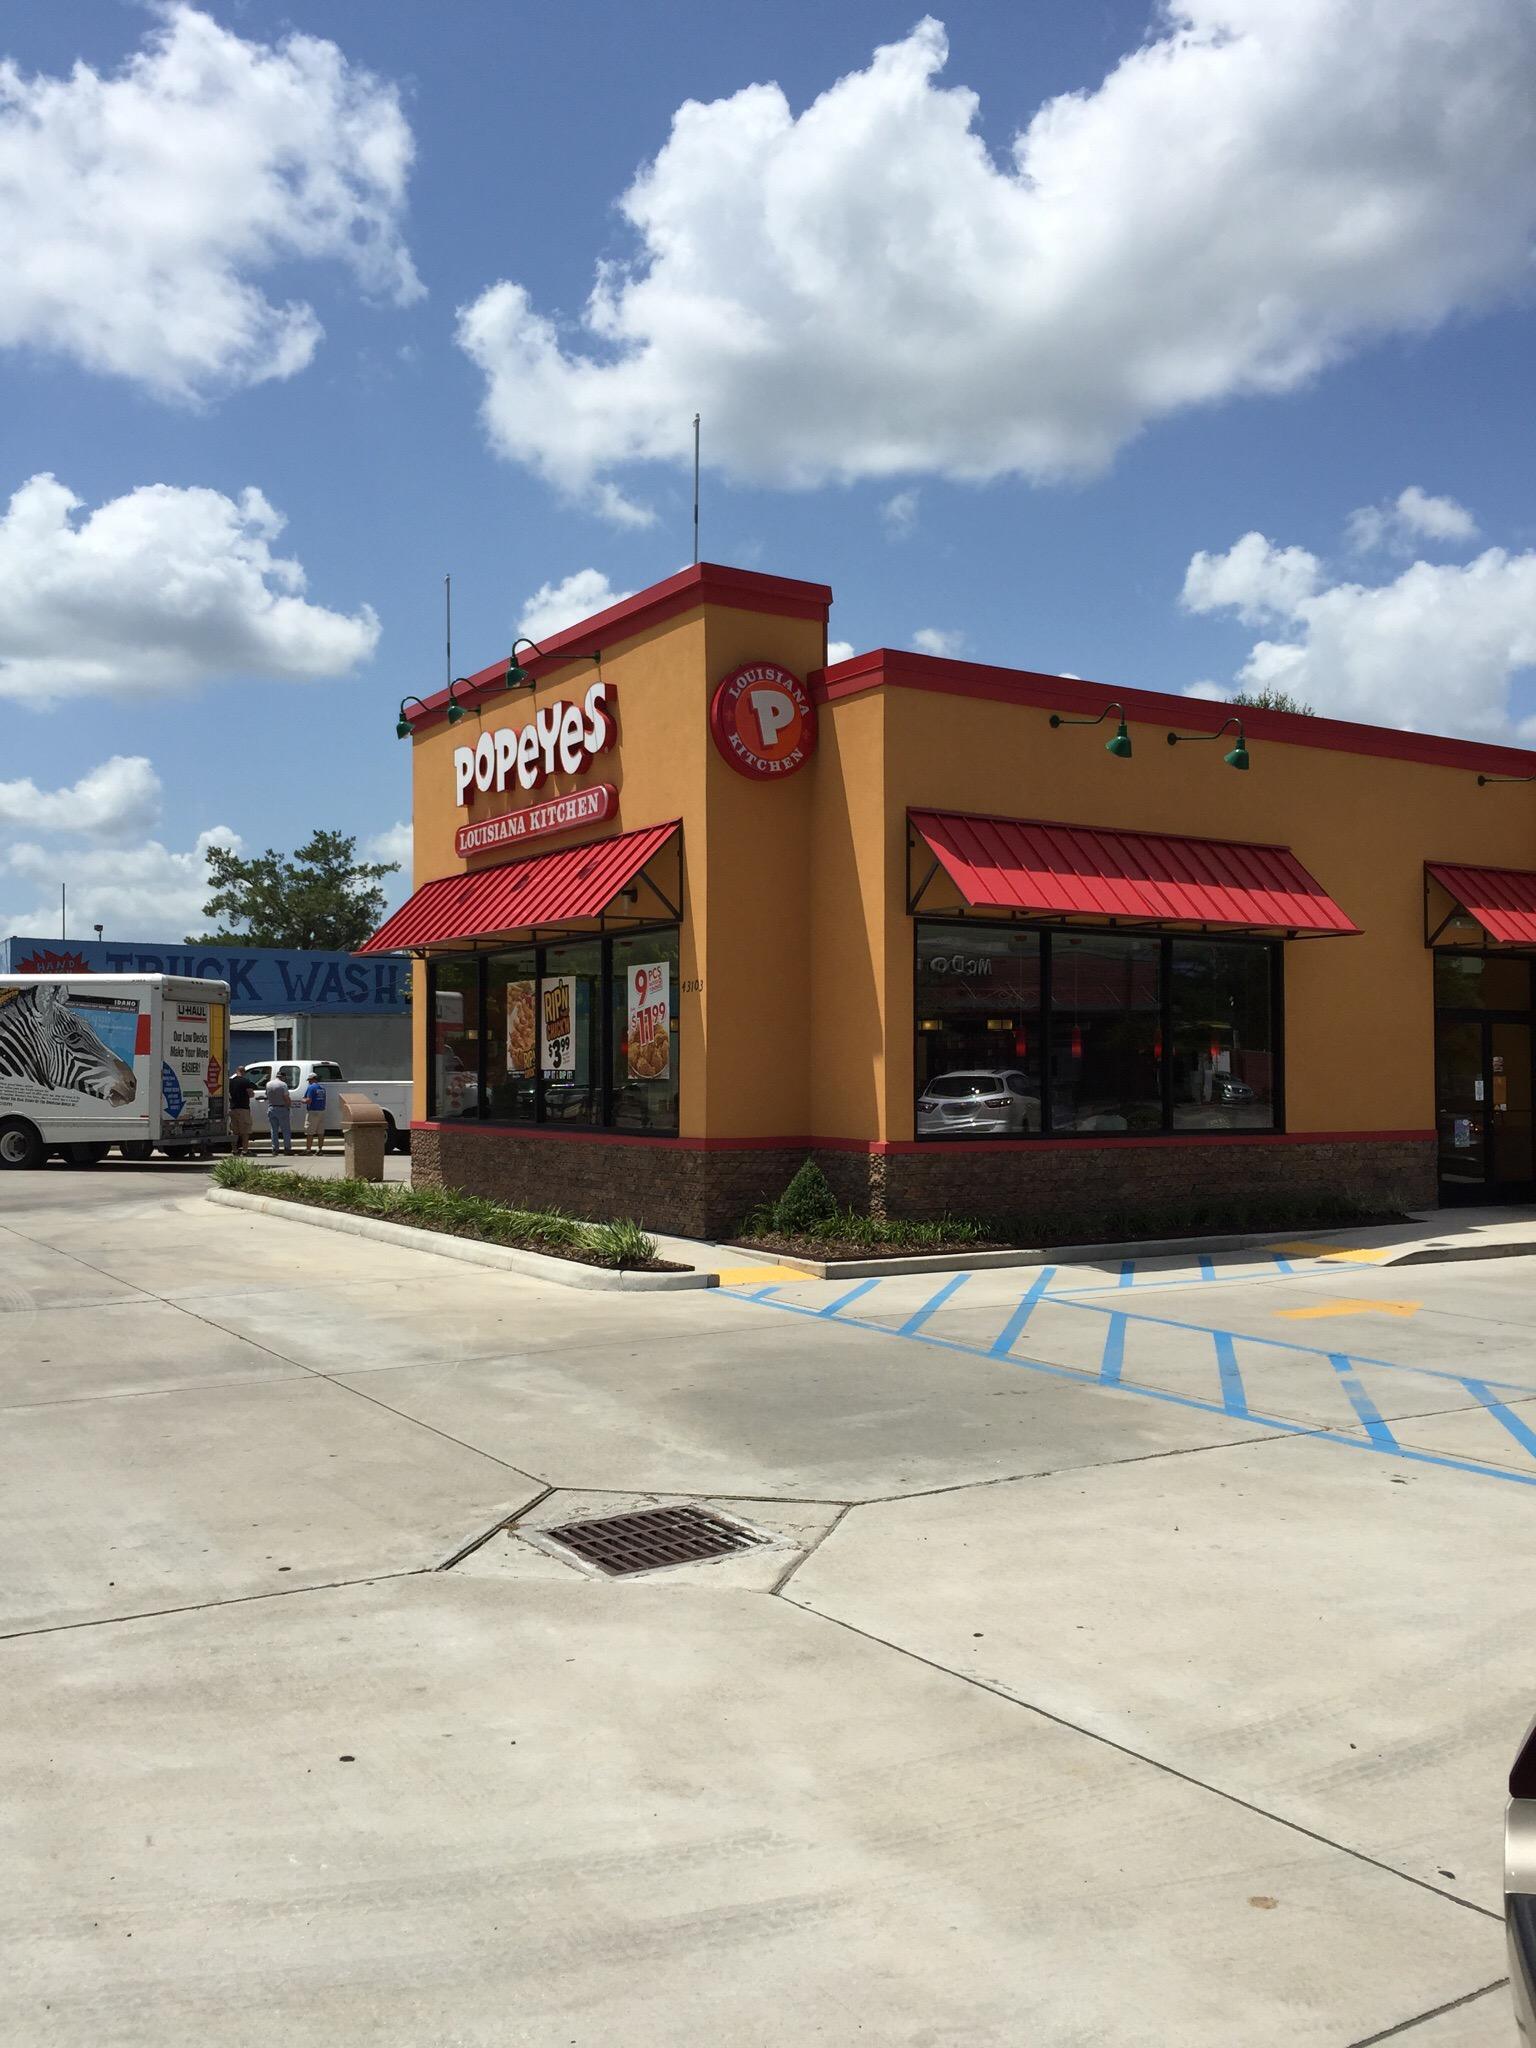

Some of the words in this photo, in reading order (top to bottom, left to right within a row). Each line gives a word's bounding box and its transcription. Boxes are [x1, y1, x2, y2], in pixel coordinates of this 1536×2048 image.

[728, 668, 809, 717] LOUISIANA
[750, 690, 795, 745] P
[728, 731, 804, 772] KITCHEN
[459, 814, 526, 851] LOUISIANA
[530, 793, 599, 831] KITCHEN
[274, 959, 399, 1005] WASH
[634, 968, 648, 1005] 9
[177, 1005, 206, 1016] U-HAUL
[170, 1046, 184, 1058] Make
[185, 1047, 195, 1058] Your
[173, 1031, 182, 1042] Our
[183, 1032, 192, 1043] Low
